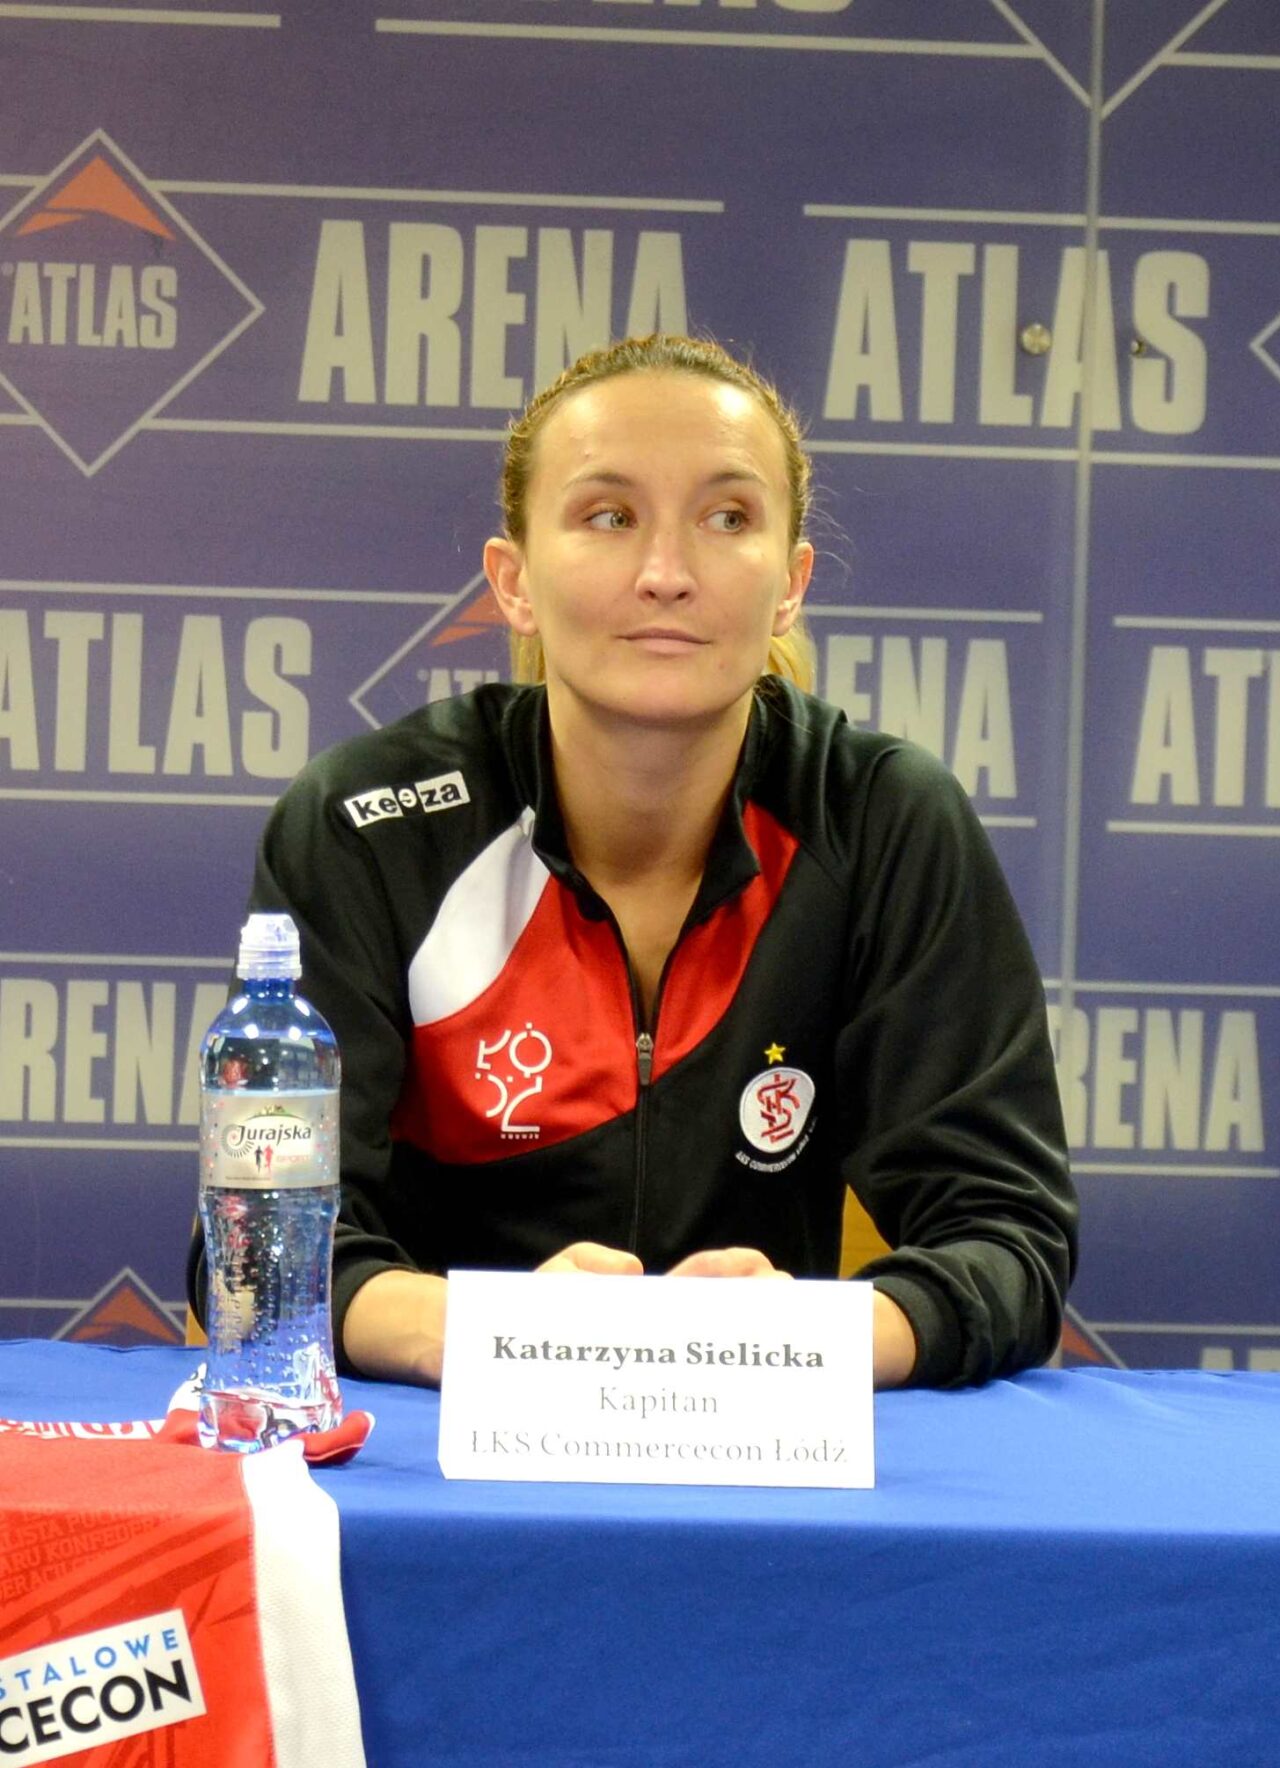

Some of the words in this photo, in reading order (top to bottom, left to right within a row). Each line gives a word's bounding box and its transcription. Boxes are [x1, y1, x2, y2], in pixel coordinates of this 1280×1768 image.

[8, 261, 178, 349] ATLAS
[822, 238, 1210, 435] ATLAS
[351, 782, 462, 822] keeza
[235, 1124, 311, 1146] Jurajska
[493, 1336, 676, 1370] Katarzyna
[686, 1341, 825, 1368] Sielicka
[600, 1387, 718, 1419] Kapitan
[540, 1432, 762, 1461] Commercecon
[0, 1659, 192, 1753] CECON
